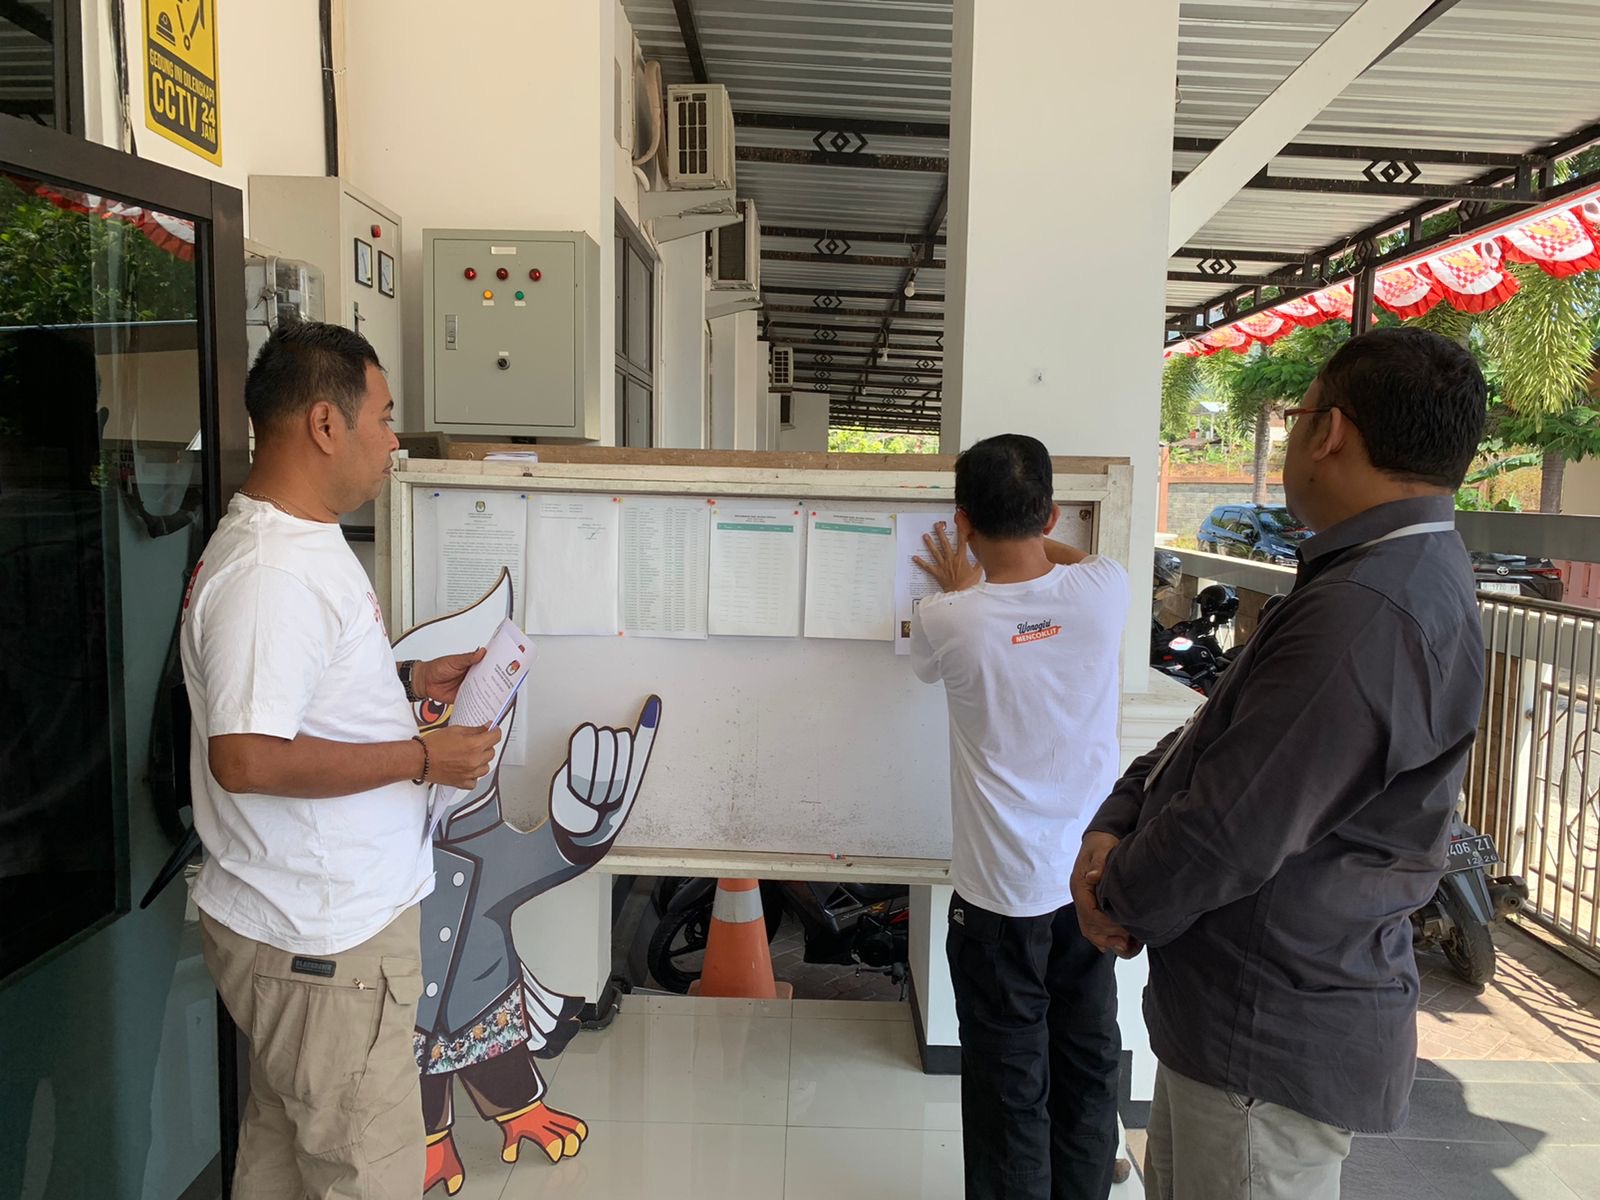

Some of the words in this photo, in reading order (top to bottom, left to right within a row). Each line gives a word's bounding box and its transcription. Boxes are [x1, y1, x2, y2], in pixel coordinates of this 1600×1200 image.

[150, 48, 174, 78] GEDUNG
[183, 70, 215, 104] DILENGKAPI
[152, 71, 197, 132] CCTV
[201, 102, 215, 127] 24
[201, 123, 215, 144] JAM
[1015, 627, 1057, 643] MENCOKLIT
[1447, 842, 1471, 857] 406
